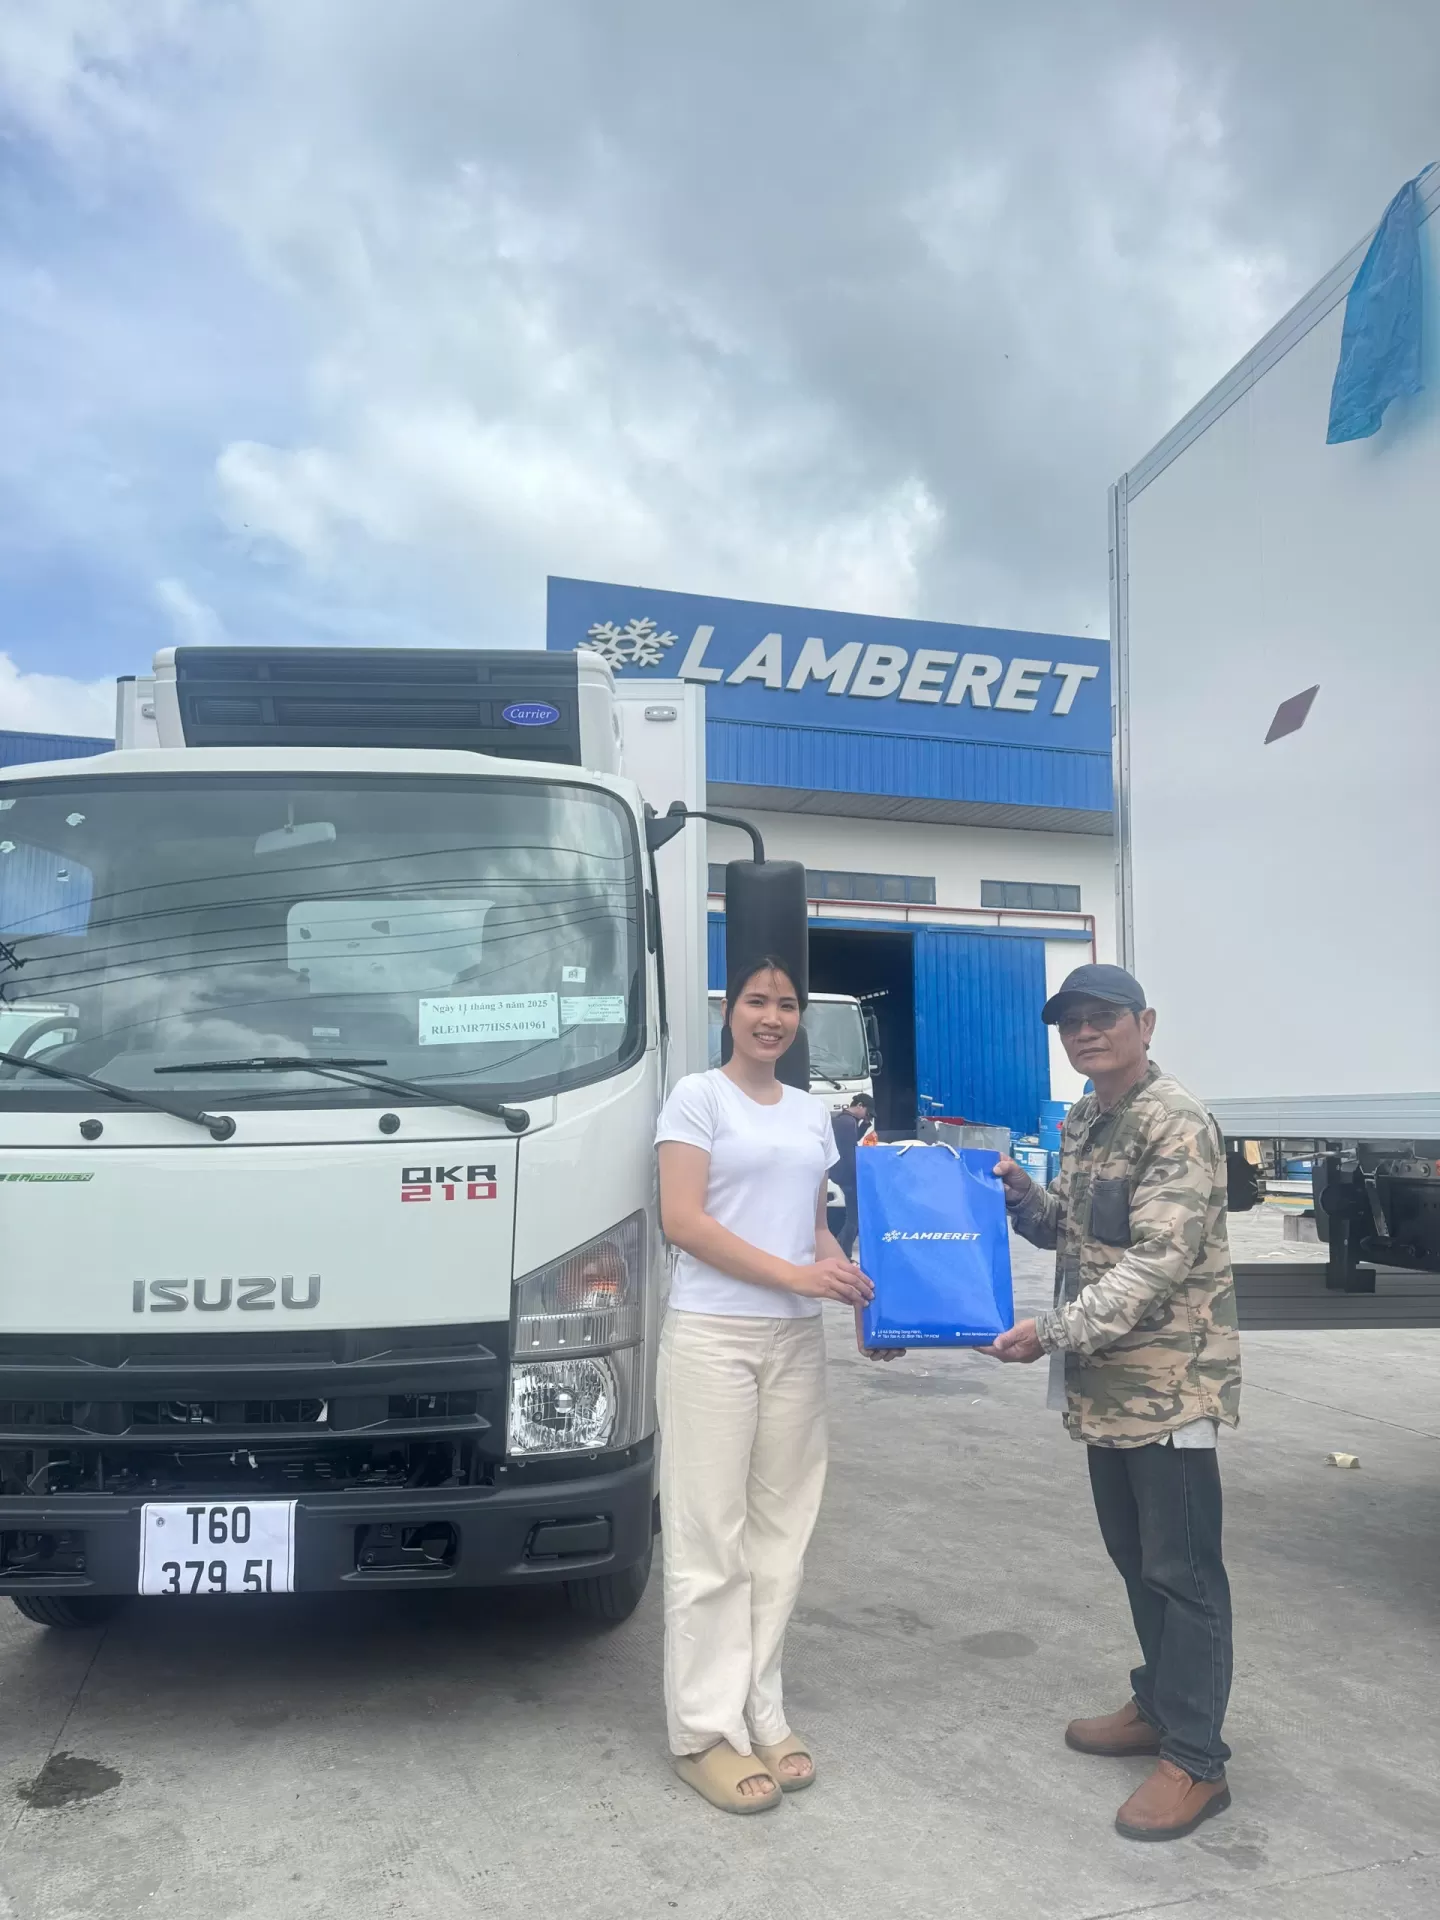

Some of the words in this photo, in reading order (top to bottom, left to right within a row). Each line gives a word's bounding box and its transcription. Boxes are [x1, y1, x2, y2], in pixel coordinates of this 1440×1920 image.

[677, 624, 1099, 716] LAMBERET
[510, 708, 552, 719] Carrier
[432, 1003, 455, 1014] Ngày
[470, 1001, 496, 1012] tháng
[498, 1001, 503, 1009] 3
[505, 1000, 525, 1009] năm
[527, 999, 548, 1008] 2025
[402, 1165, 497, 1184] QKR
[401, 1183, 497, 1202] 210
[901, 1232, 981, 1241] LAMBERET
[133, 1273, 321, 1313] ISUZU
[186, 1506, 251, 1544] T60
